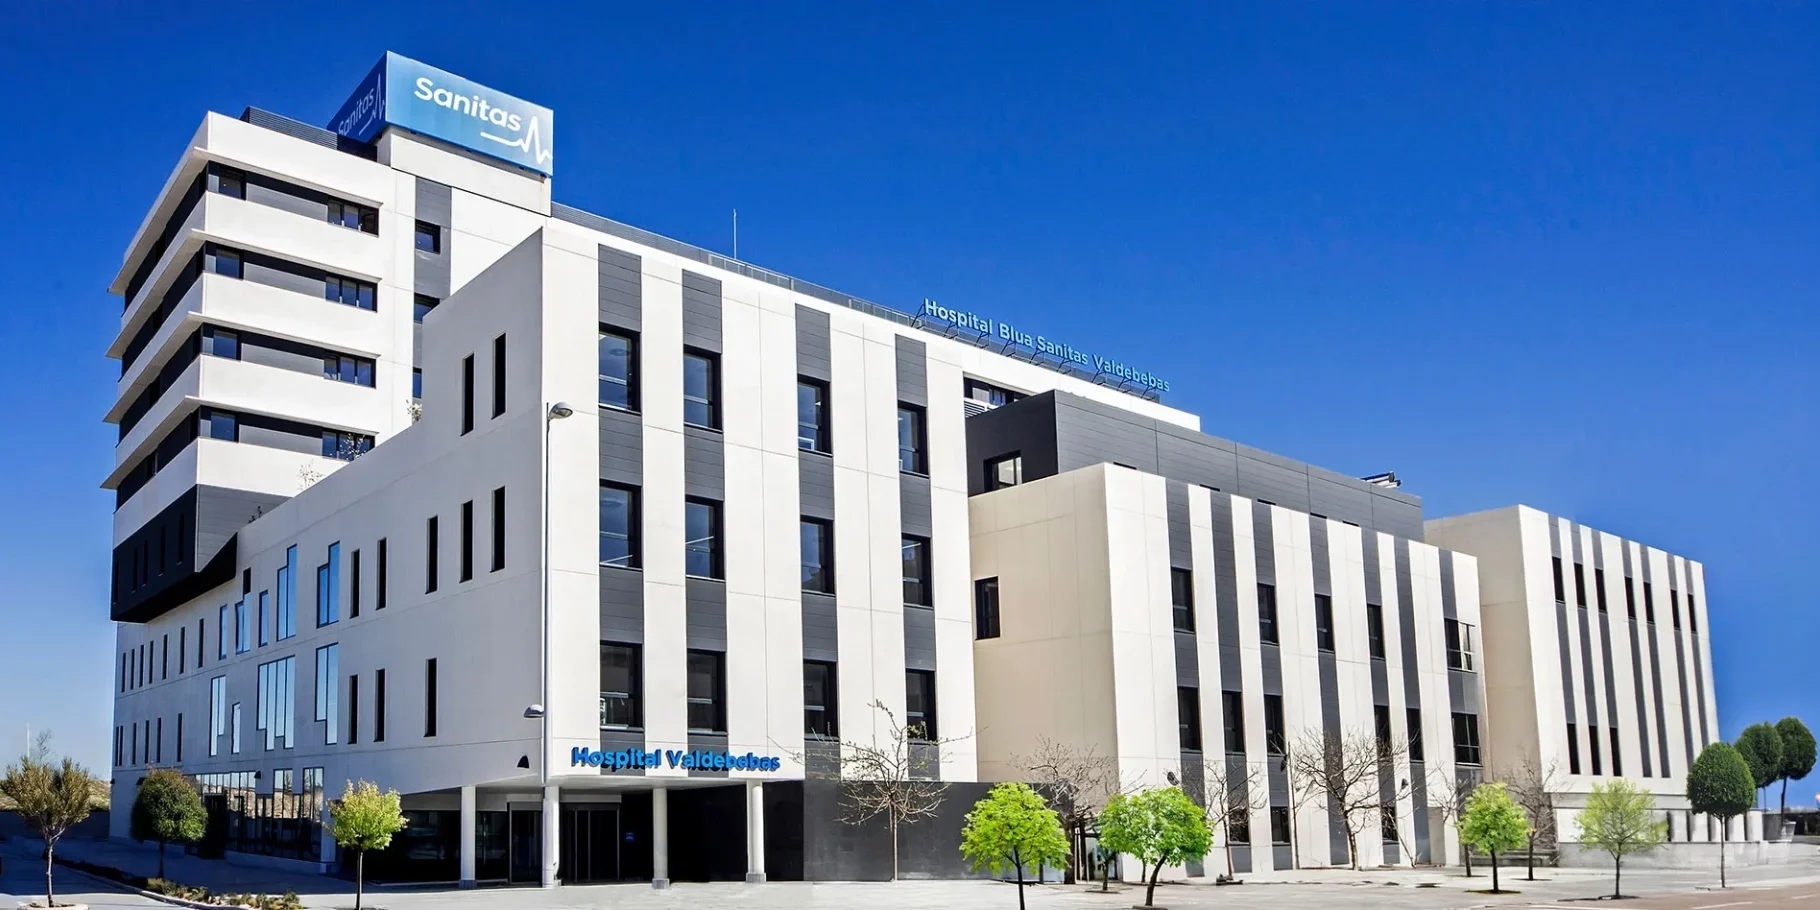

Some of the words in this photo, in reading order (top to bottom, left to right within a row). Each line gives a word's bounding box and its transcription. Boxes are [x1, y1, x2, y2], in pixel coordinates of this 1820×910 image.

[413, 76, 522, 132] Sanitas
[924, 298, 994, 335] Hospital
[998, 322, 1033, 347] Blua
[1036, 335, 1089, 366] Sanitas
[1092, 354, 1170, 392] Valdebebas
[571, 747, 662, 771] Hospital
[665, 749, 781, 773] Valdebebas
